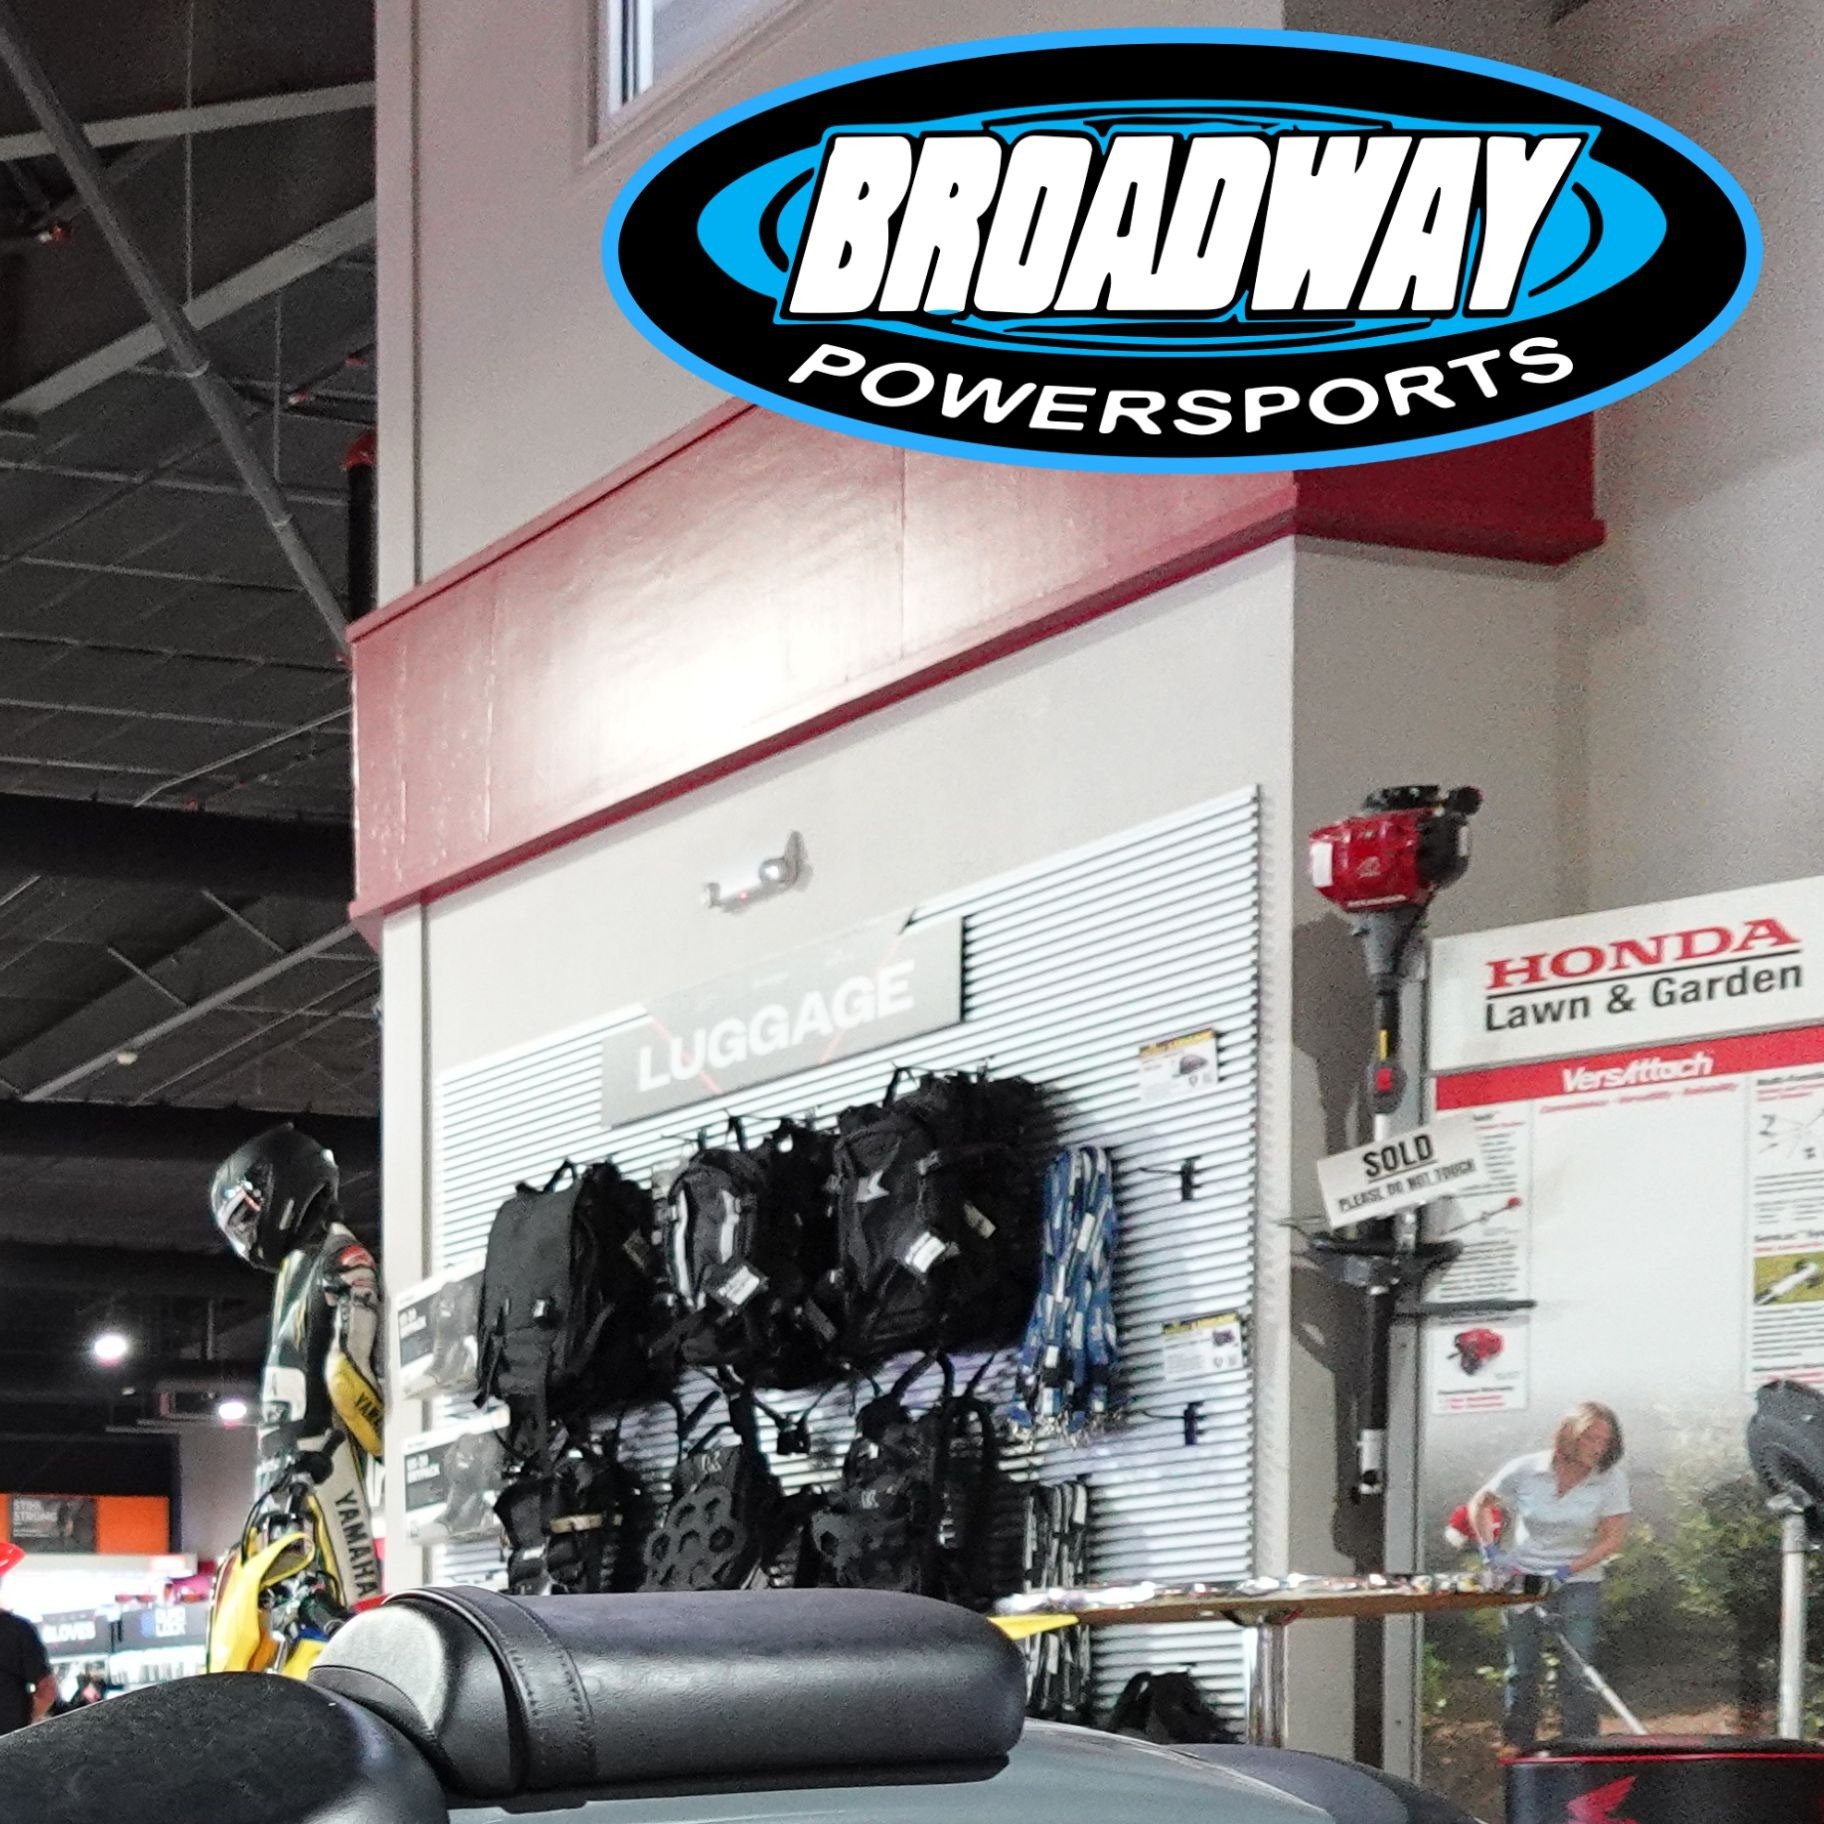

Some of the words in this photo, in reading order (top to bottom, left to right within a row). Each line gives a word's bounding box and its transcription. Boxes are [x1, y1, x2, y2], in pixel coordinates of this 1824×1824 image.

[1485, 917, 1802, 990] HONDA
[638, 959, 915, 1092] LUGGAGE
[1486, 994, 1591, 1032] Lawn
[1607, 984, 1636, 1015] &
[1653, 963, 1804, 1008] Garden
[1363, 1134, 1434, 1178] SOLD
[334, 1488, 380, 1598] YAMAHA
